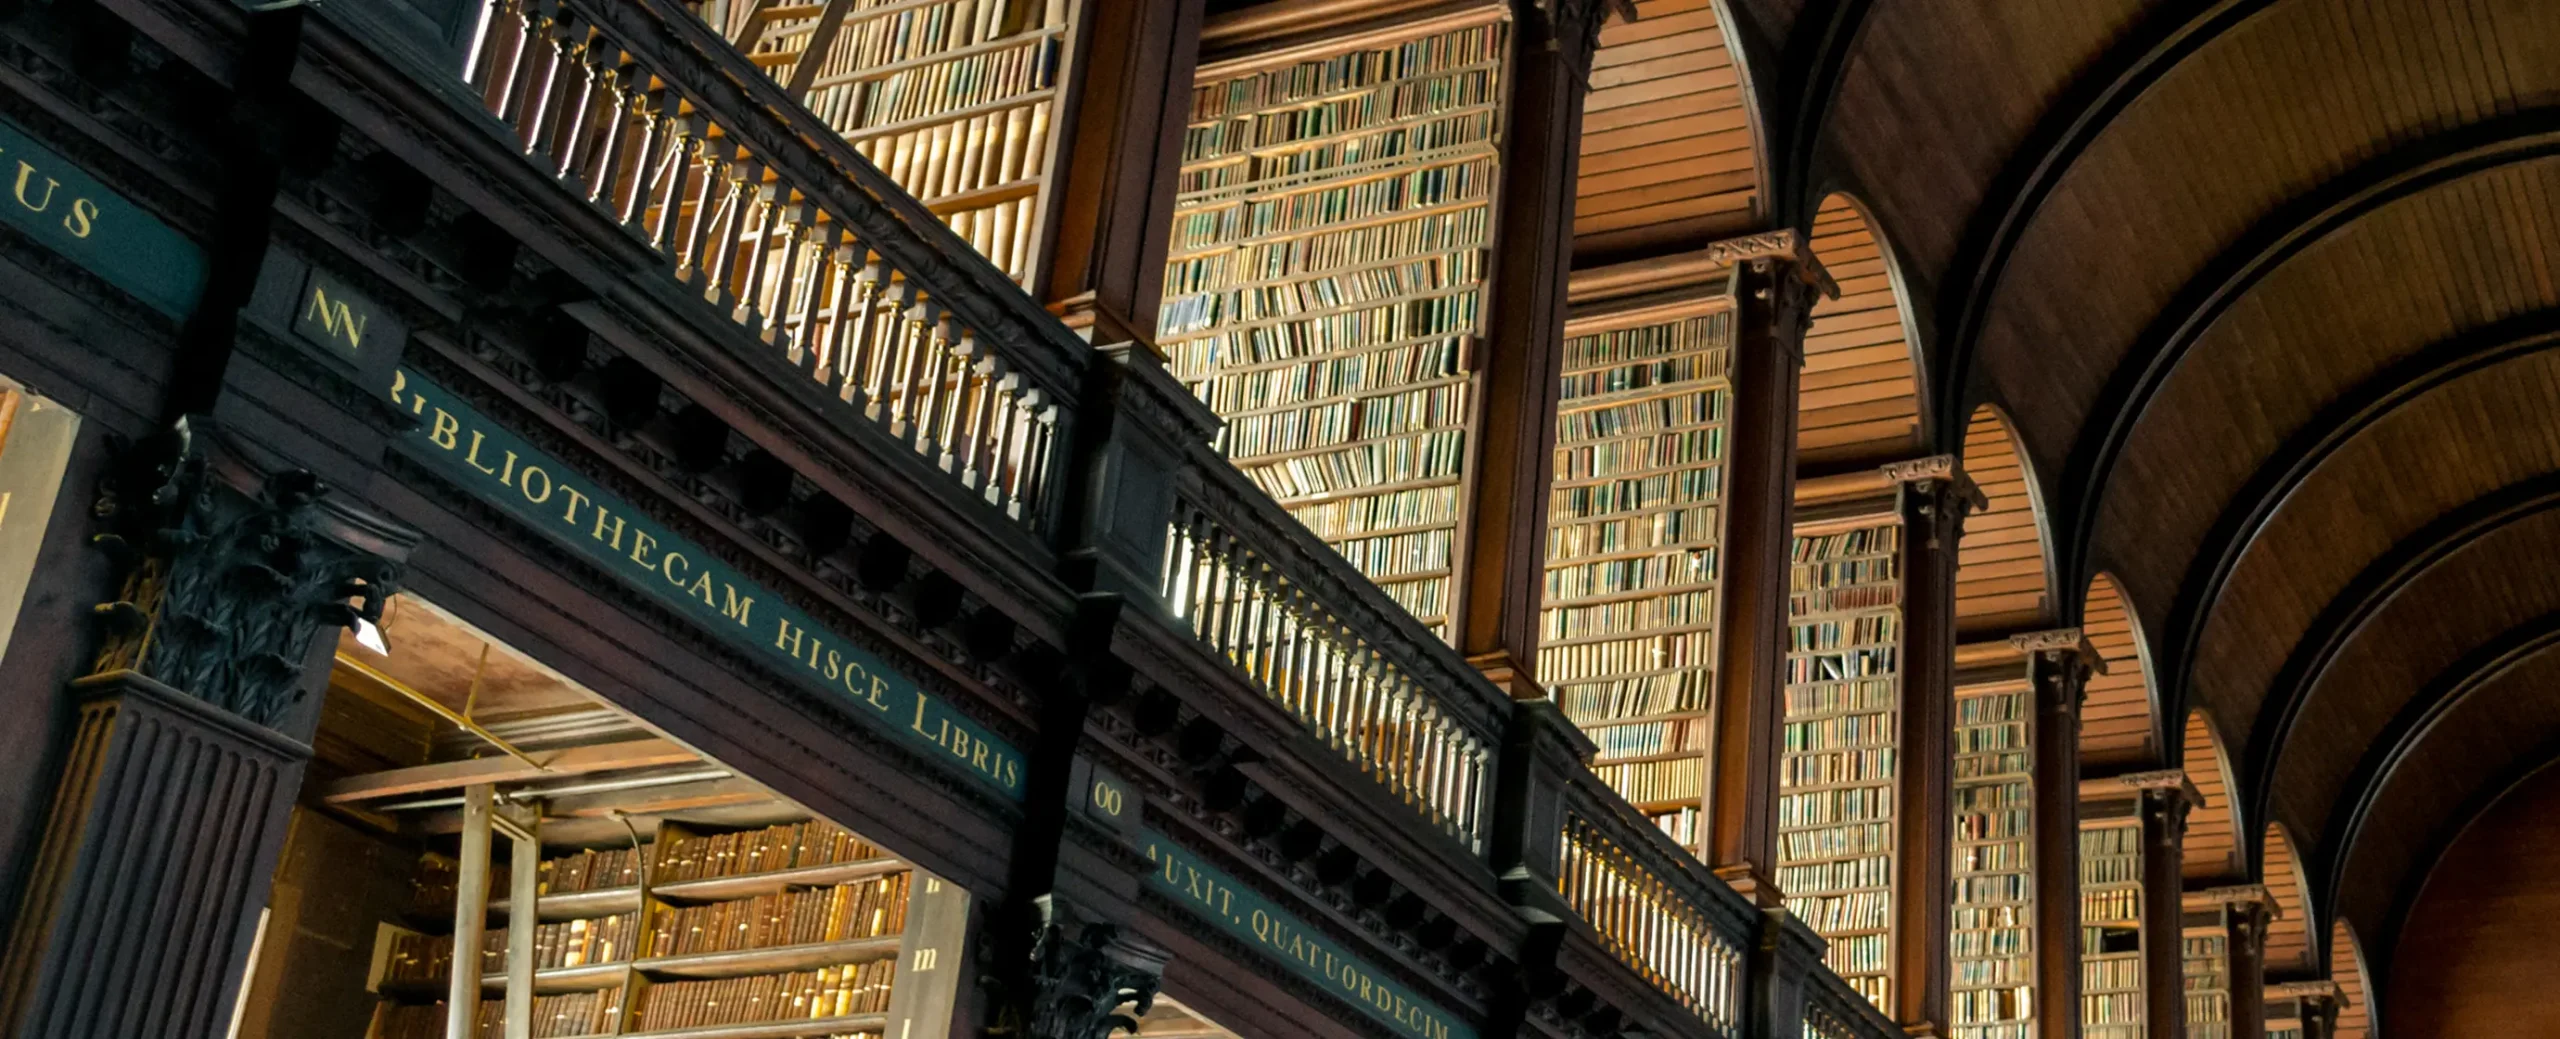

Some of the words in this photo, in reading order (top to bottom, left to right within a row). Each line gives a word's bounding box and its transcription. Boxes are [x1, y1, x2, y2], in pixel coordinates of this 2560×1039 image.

[0, 148, 99, 238] US
[307, 285, 367, 348] NN
[775, 617, 890, 713] HISCE
[911, 691, 1018, 788] LIBRIS
[912, 948, 937, 972] m
